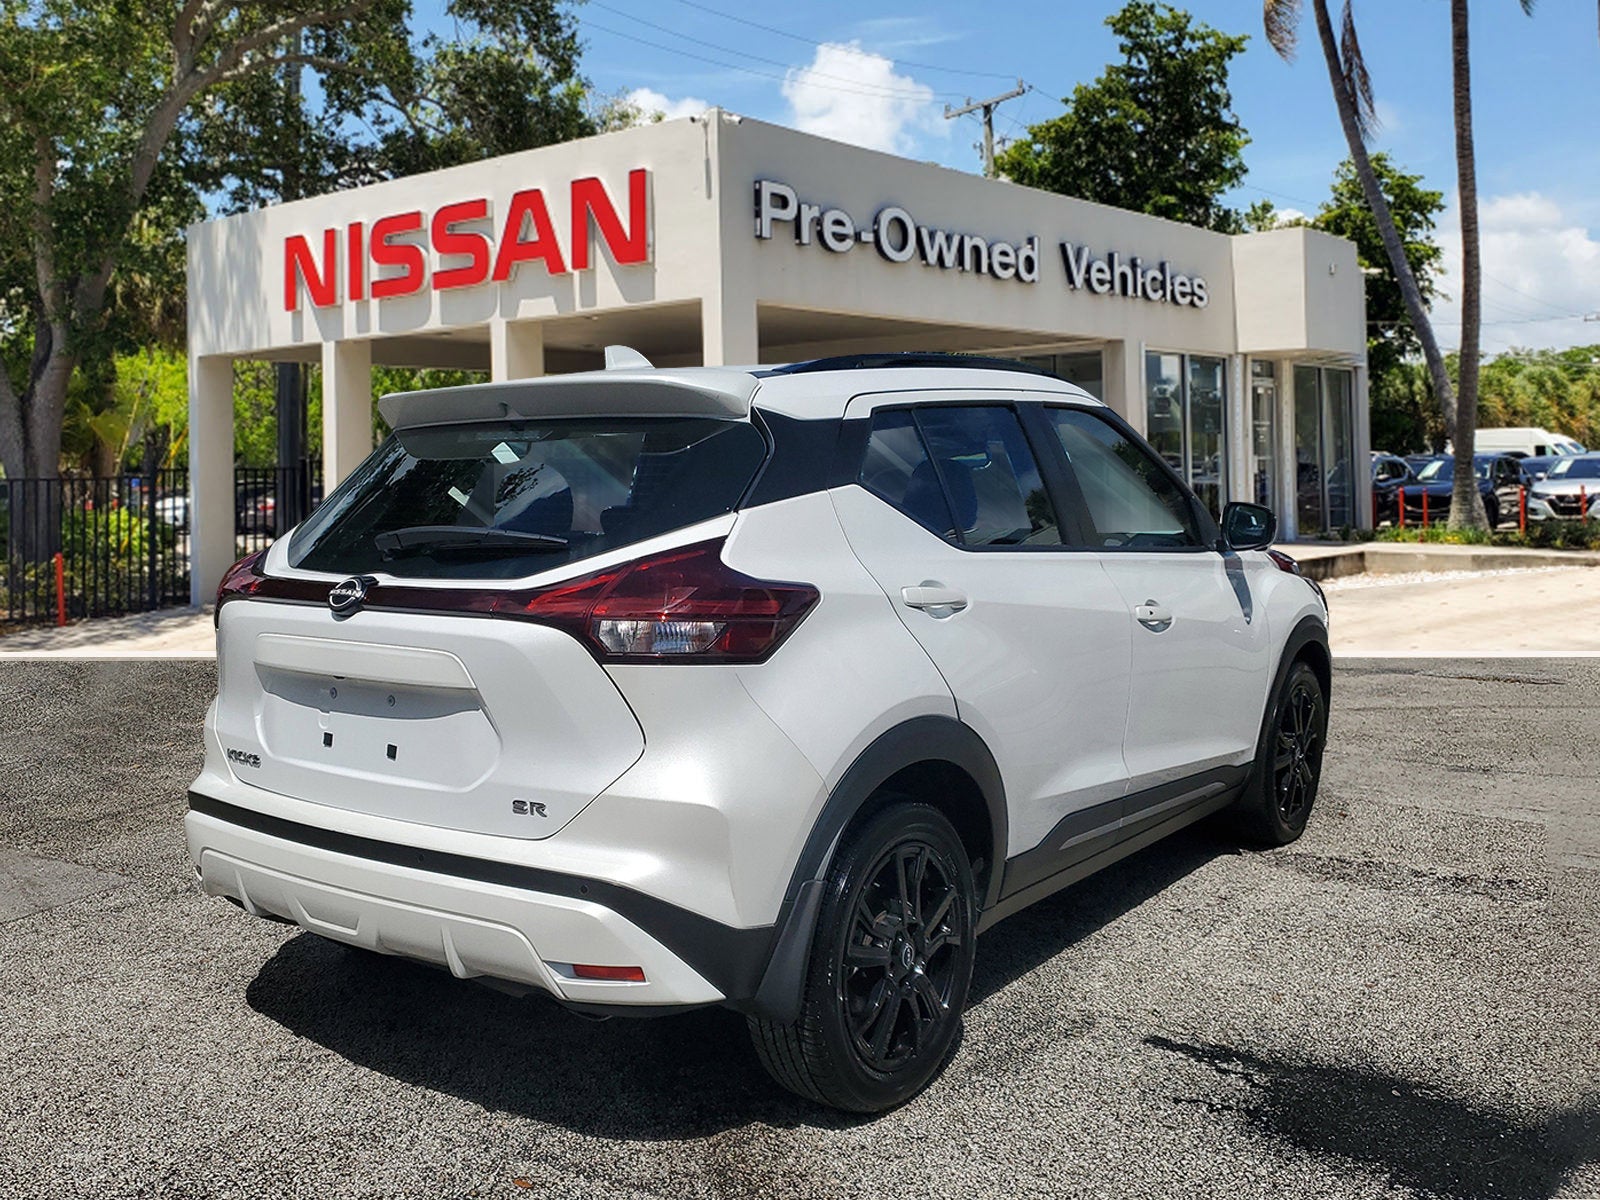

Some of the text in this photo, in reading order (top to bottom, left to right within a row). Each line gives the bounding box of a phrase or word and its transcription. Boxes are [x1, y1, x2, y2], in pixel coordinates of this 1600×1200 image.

[284, 168, 651, 312] NISSAN
[754, 180, 1208, 308] Pre-Owned Vehicles
[226, 747, 261, 769] KICKS
[512, 799, 548, 818] SR
